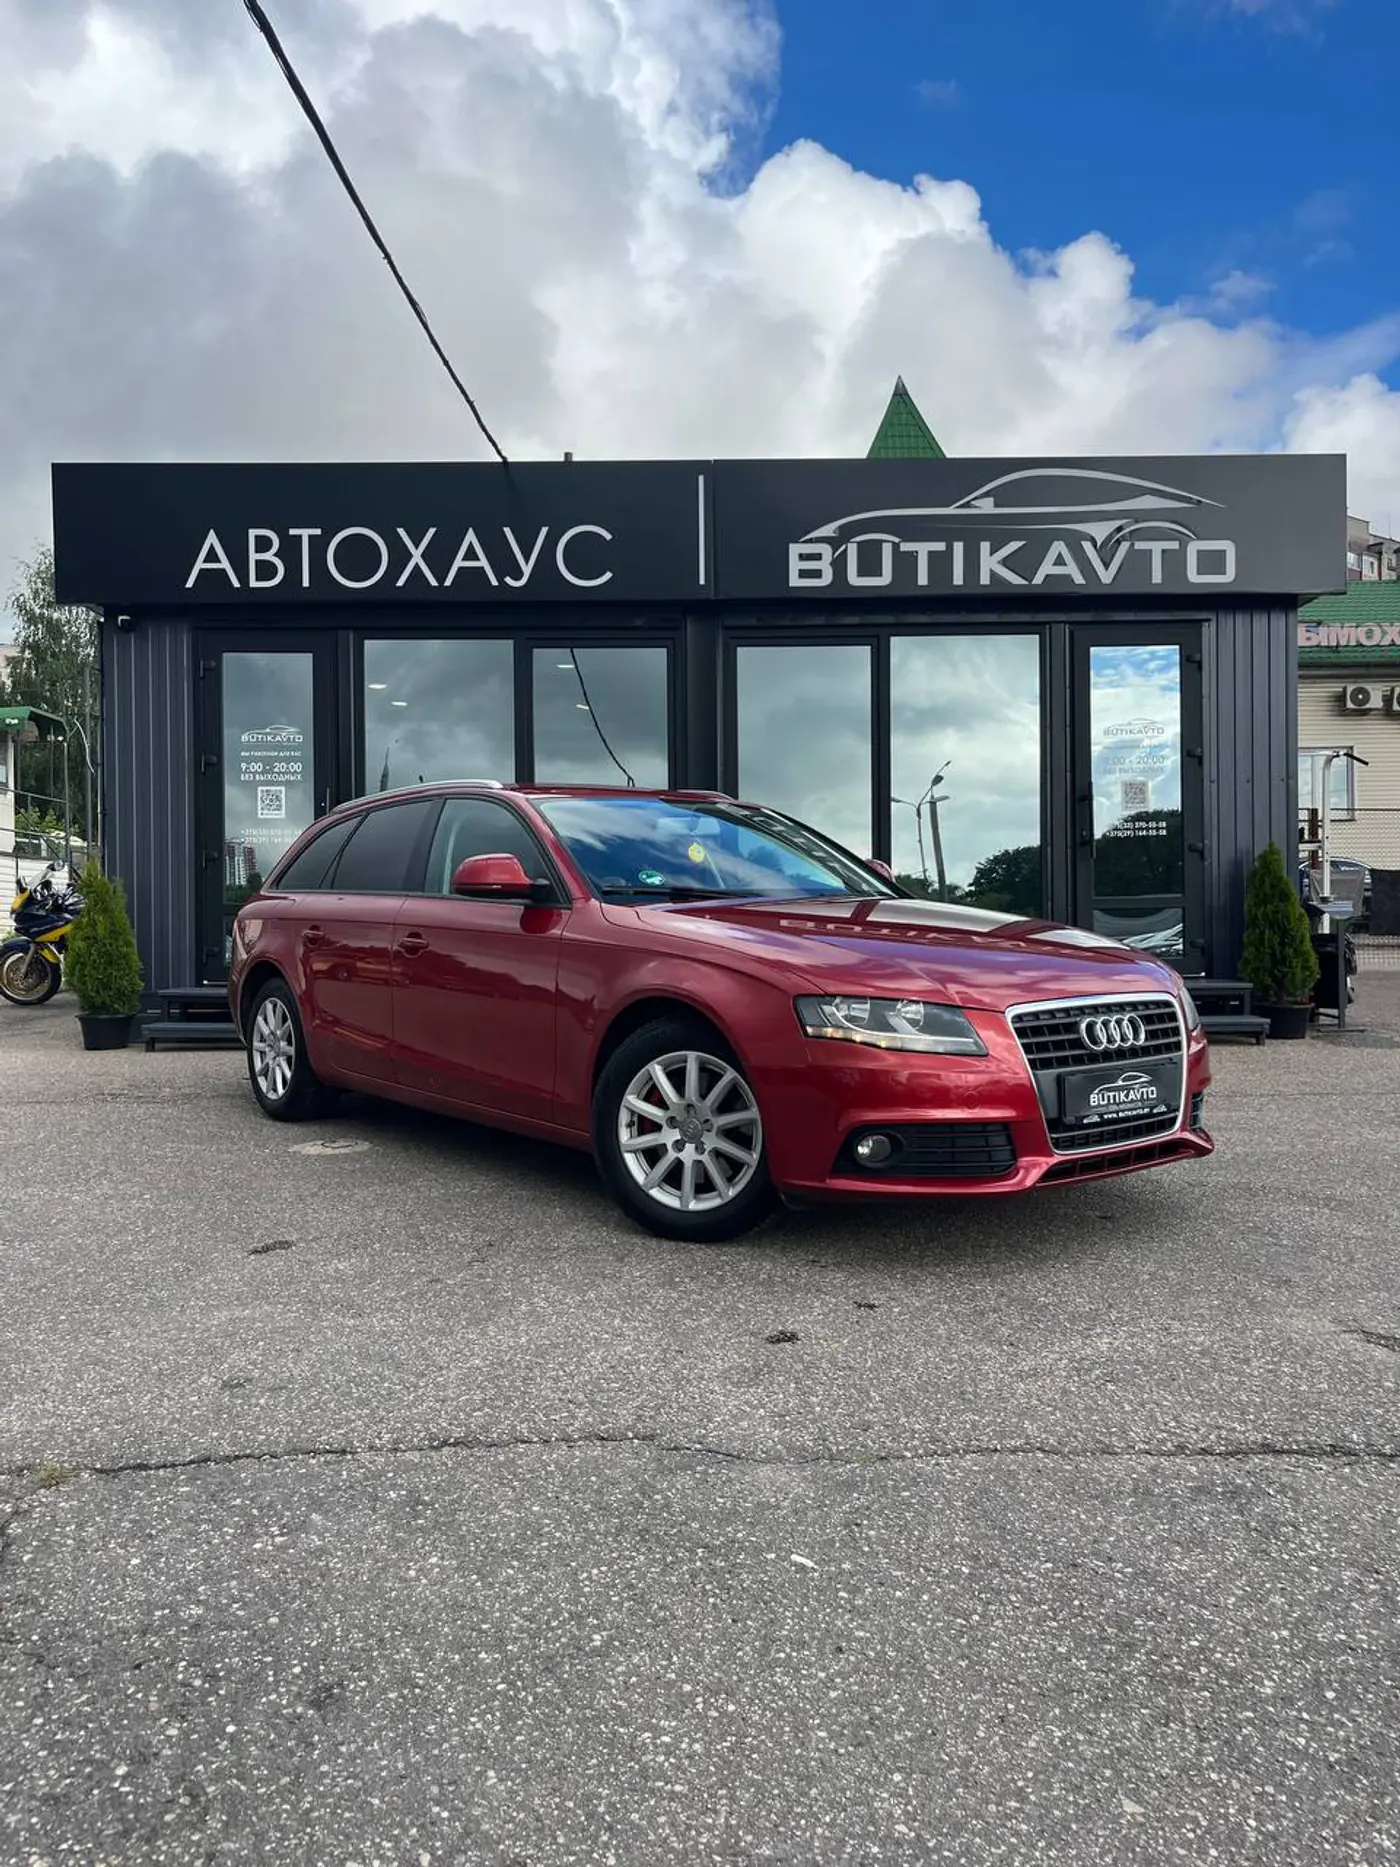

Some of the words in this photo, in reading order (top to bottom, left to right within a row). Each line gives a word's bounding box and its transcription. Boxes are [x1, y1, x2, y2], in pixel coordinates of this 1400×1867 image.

[185, 525, 613, 588] АВТОХАУС
[789, 540, 1237, 588] BUTIKAVTO
[1103, 727, 1165, 736] BUTIKAVTO
[241, 734, 303, 742] BUTIKAVTO
[240, 762, 263, 773] 9:00
[273, 762, 303, 773] 20:00
[240, 773, 253, 781] БЕЗ
[256, 773, 302, 781] ВЫХОДНЫХ
[1089, 1086, 1157, 1106] BUTIKAVTO
